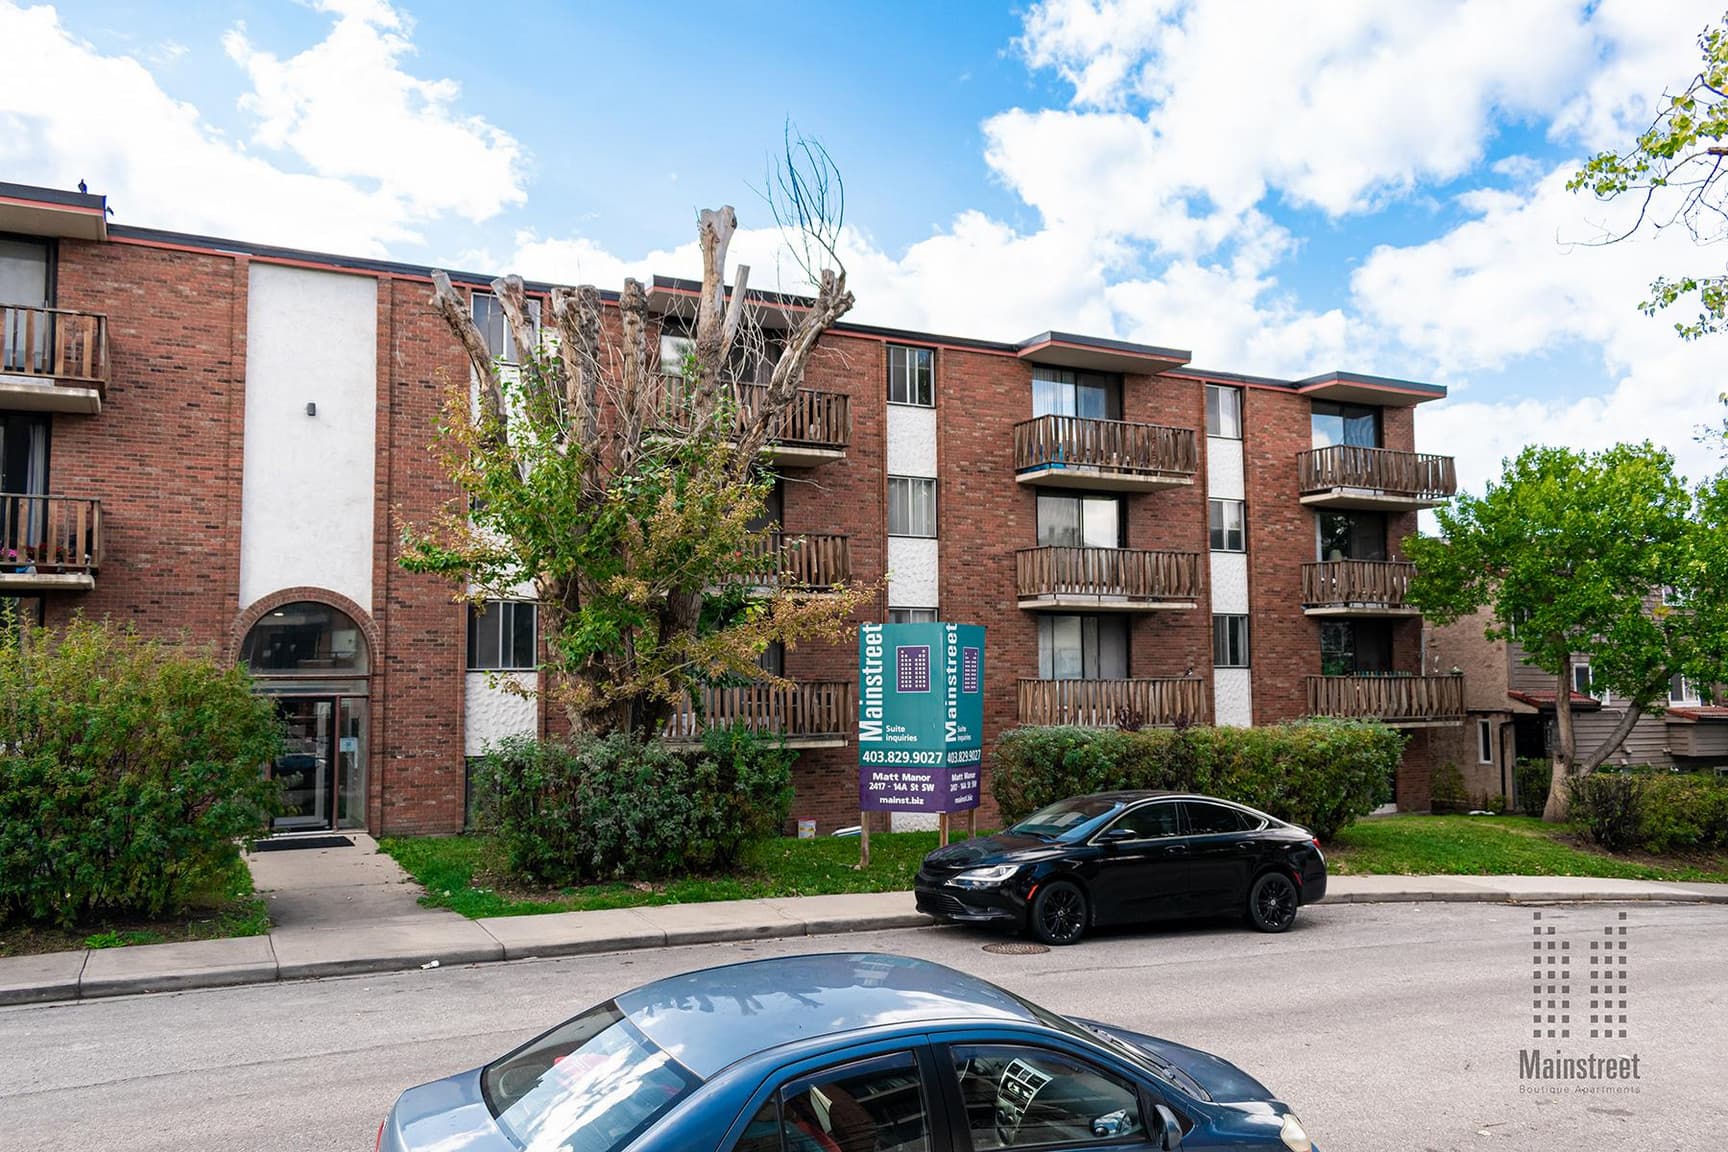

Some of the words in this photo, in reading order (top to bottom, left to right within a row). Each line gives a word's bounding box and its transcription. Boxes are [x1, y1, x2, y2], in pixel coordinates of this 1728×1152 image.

[859, 623, 882, 741] Mainstreet
[945, 622, 957, 742] Mainstreet
[886, 725, 906, 733] Suite
[886, 734, 918, 743] inquiries
[862, 751, 943, 764] 403.829.9027
[948, 750, 981, 763] 403.829.9027
[872, 772, 899, 781] Matt
[902, 773, 931, 782] Manor
[868, 782, 886, 790] 2417
[894, 782, 908, 791] 14A
[910, 783, 919, 792] St
[922, 784, 934, 792] SW
[880, 796, 925, 805] mainst.biz
